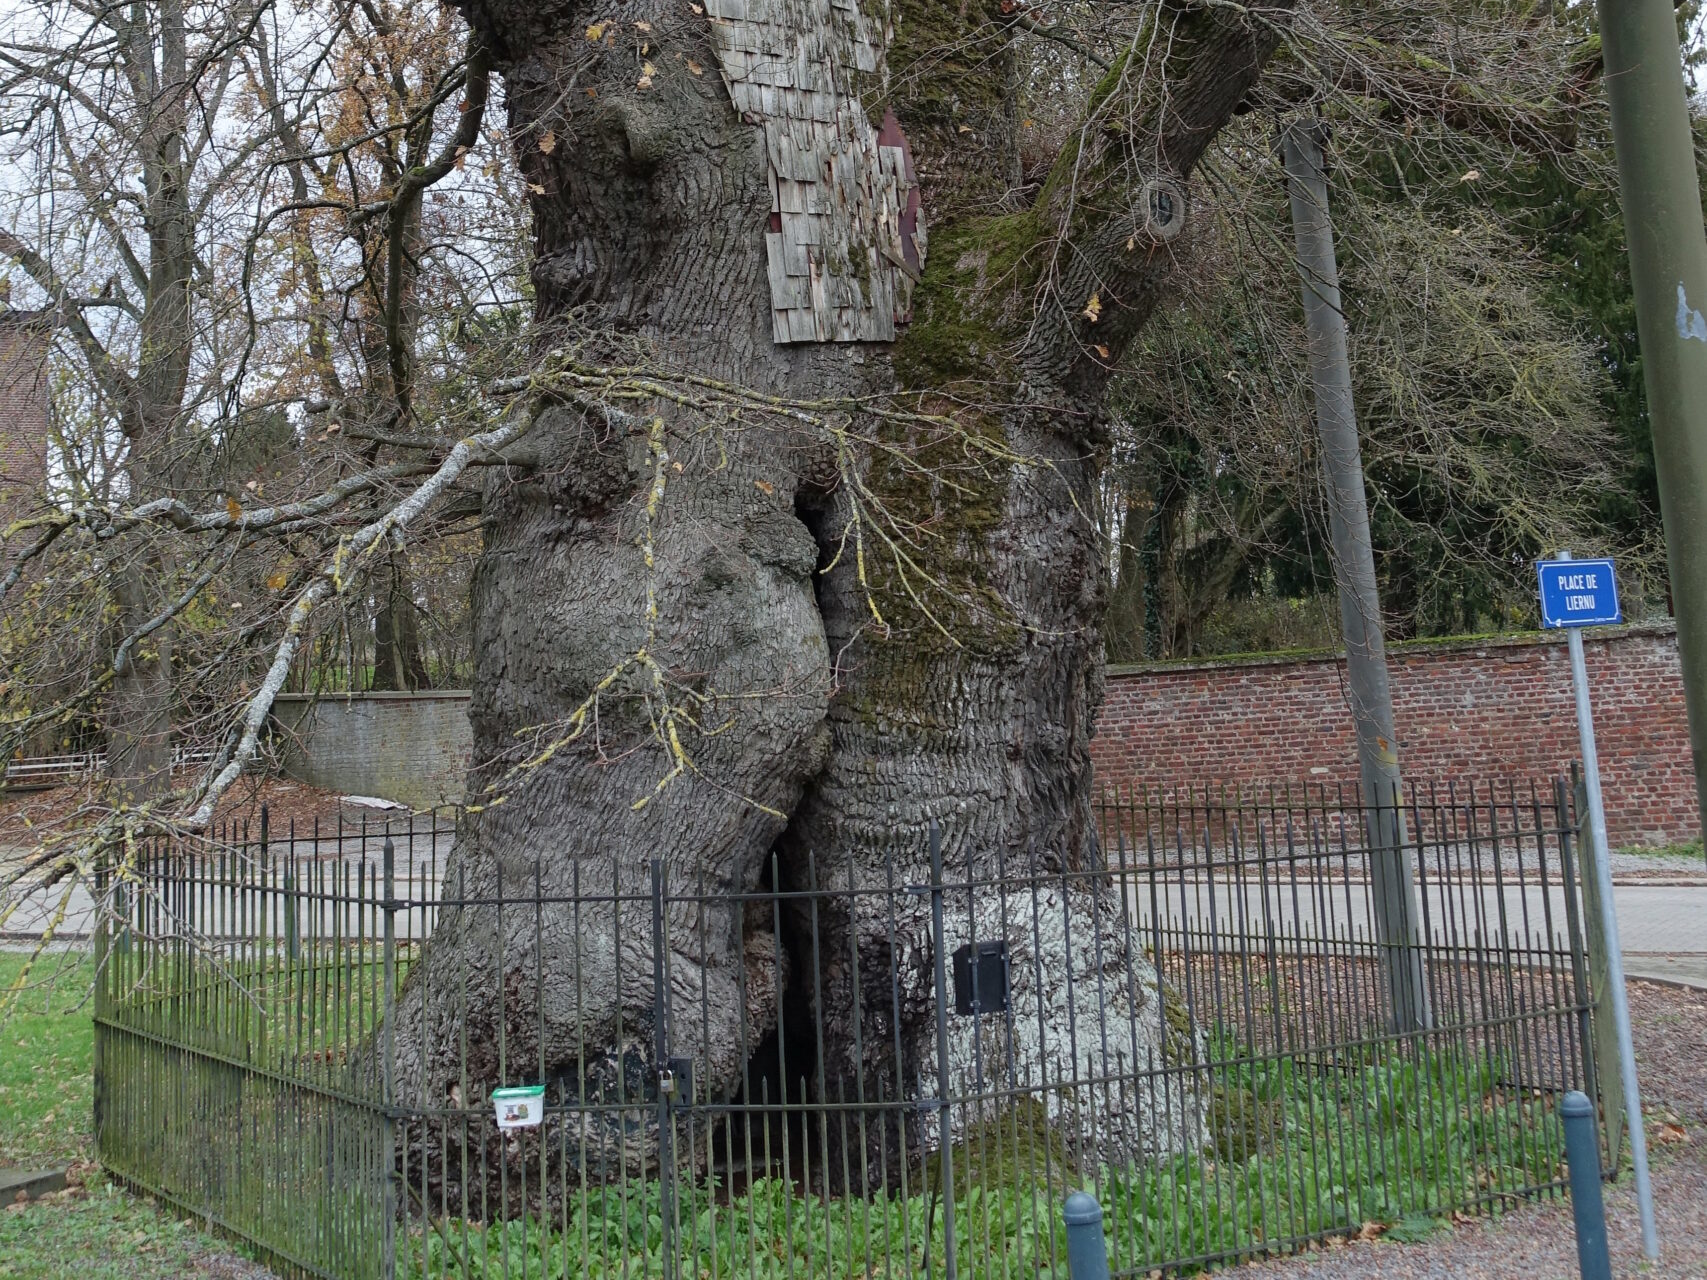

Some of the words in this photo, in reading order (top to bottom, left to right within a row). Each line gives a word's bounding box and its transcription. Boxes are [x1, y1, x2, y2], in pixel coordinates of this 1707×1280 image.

[1558, 575, 1585, 590] PLACE
[1585, 574, 1598, 589] DE
[1565, 595, 1595, 610] LIERNU
